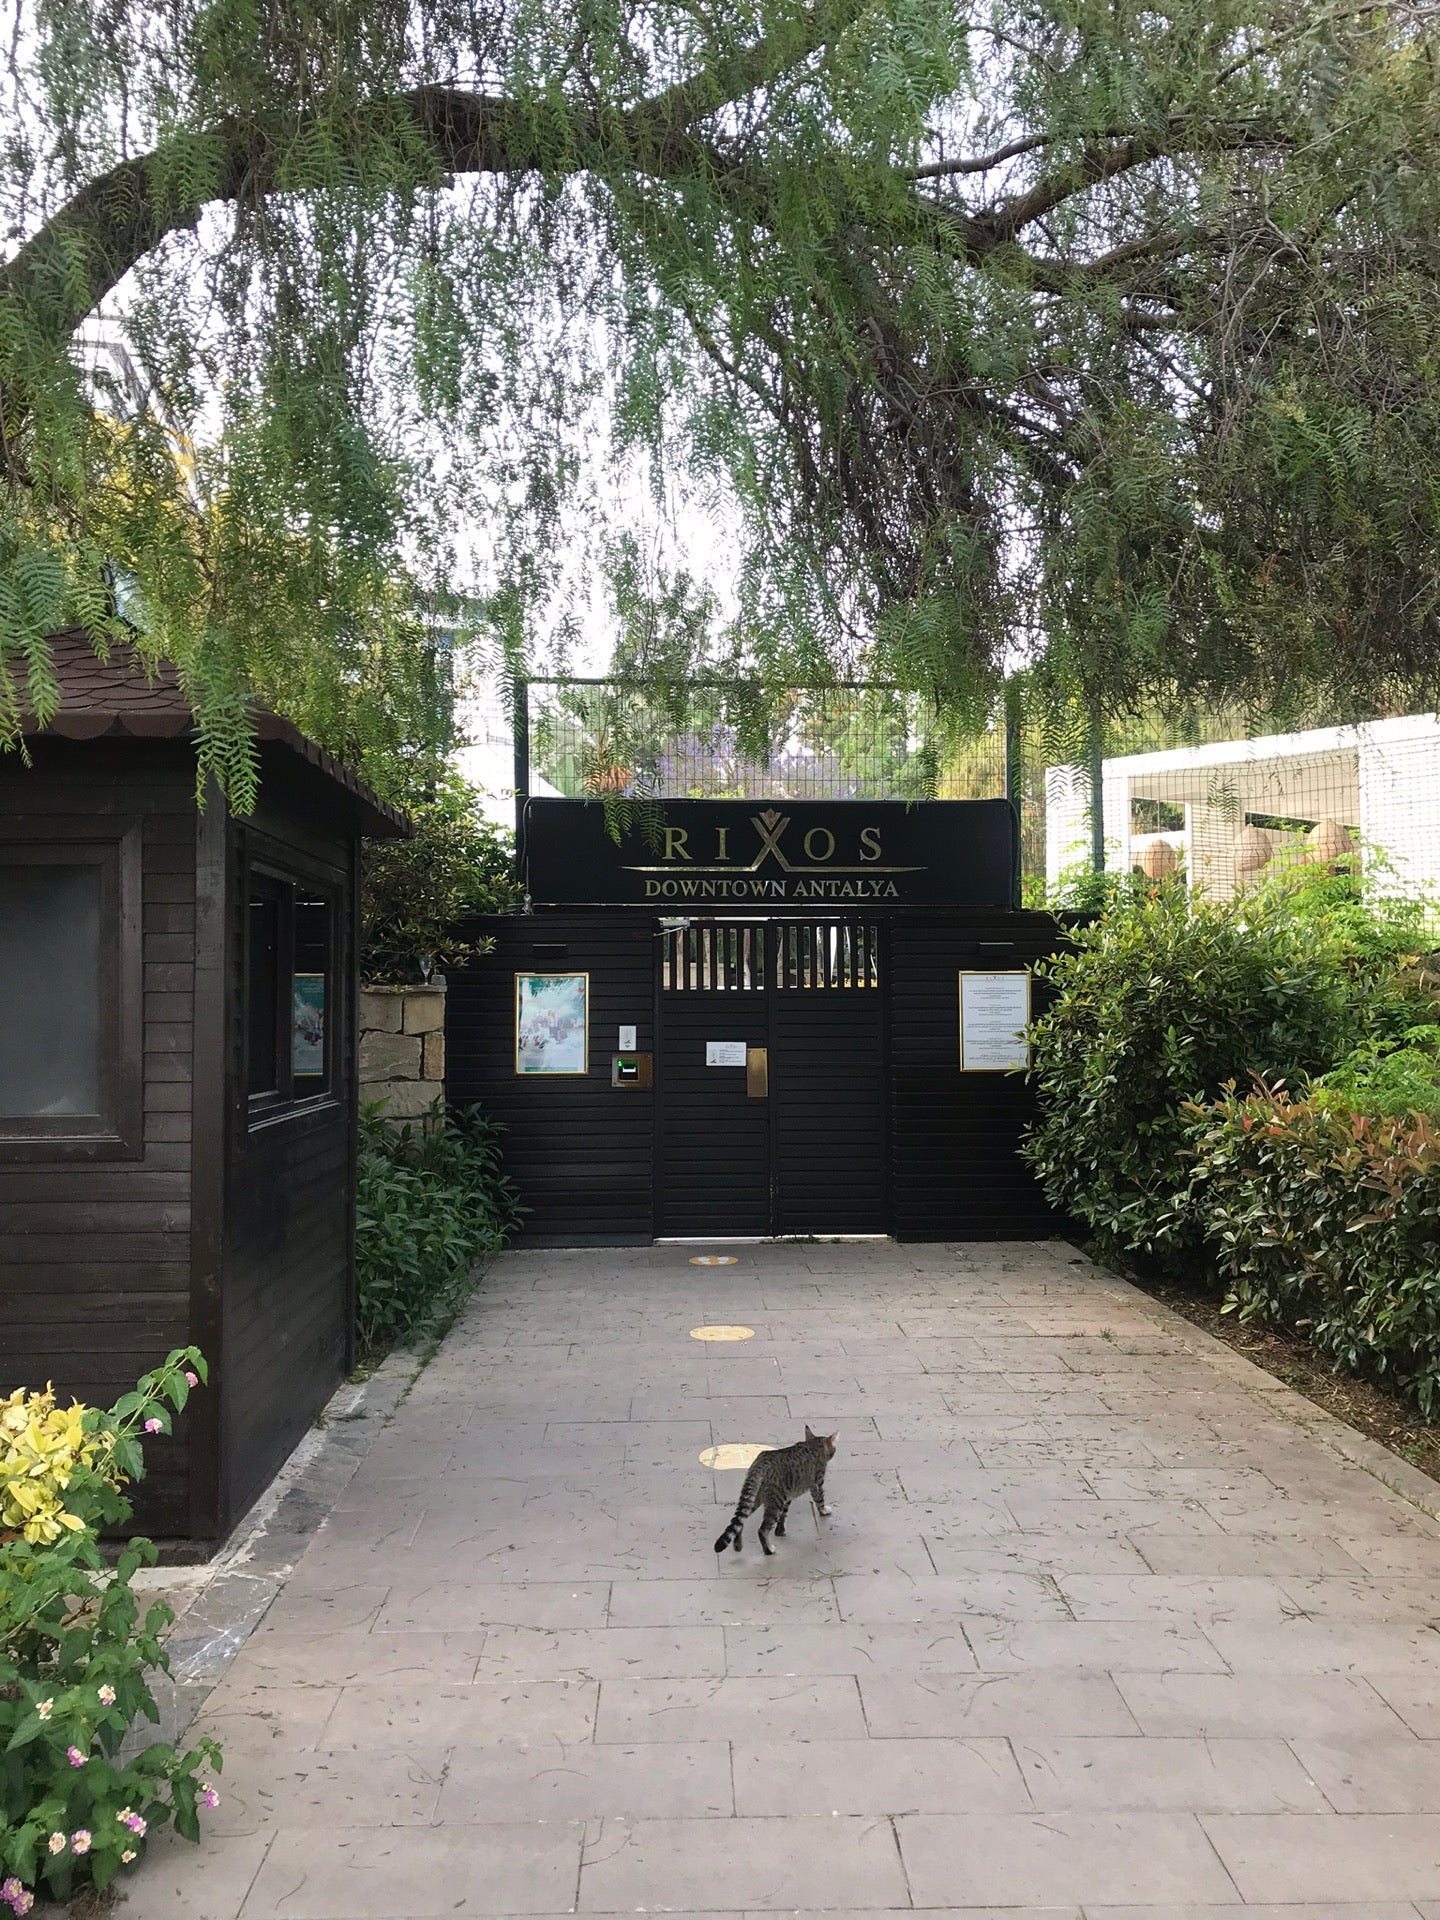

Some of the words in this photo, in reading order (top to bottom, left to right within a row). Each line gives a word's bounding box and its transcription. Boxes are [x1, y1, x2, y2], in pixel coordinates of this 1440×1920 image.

[661, 815, 883, 872] RIXOS
[644, 879, 786, 898] DOWNTOWN
[793, 879, 900, 898] ANTALYA
